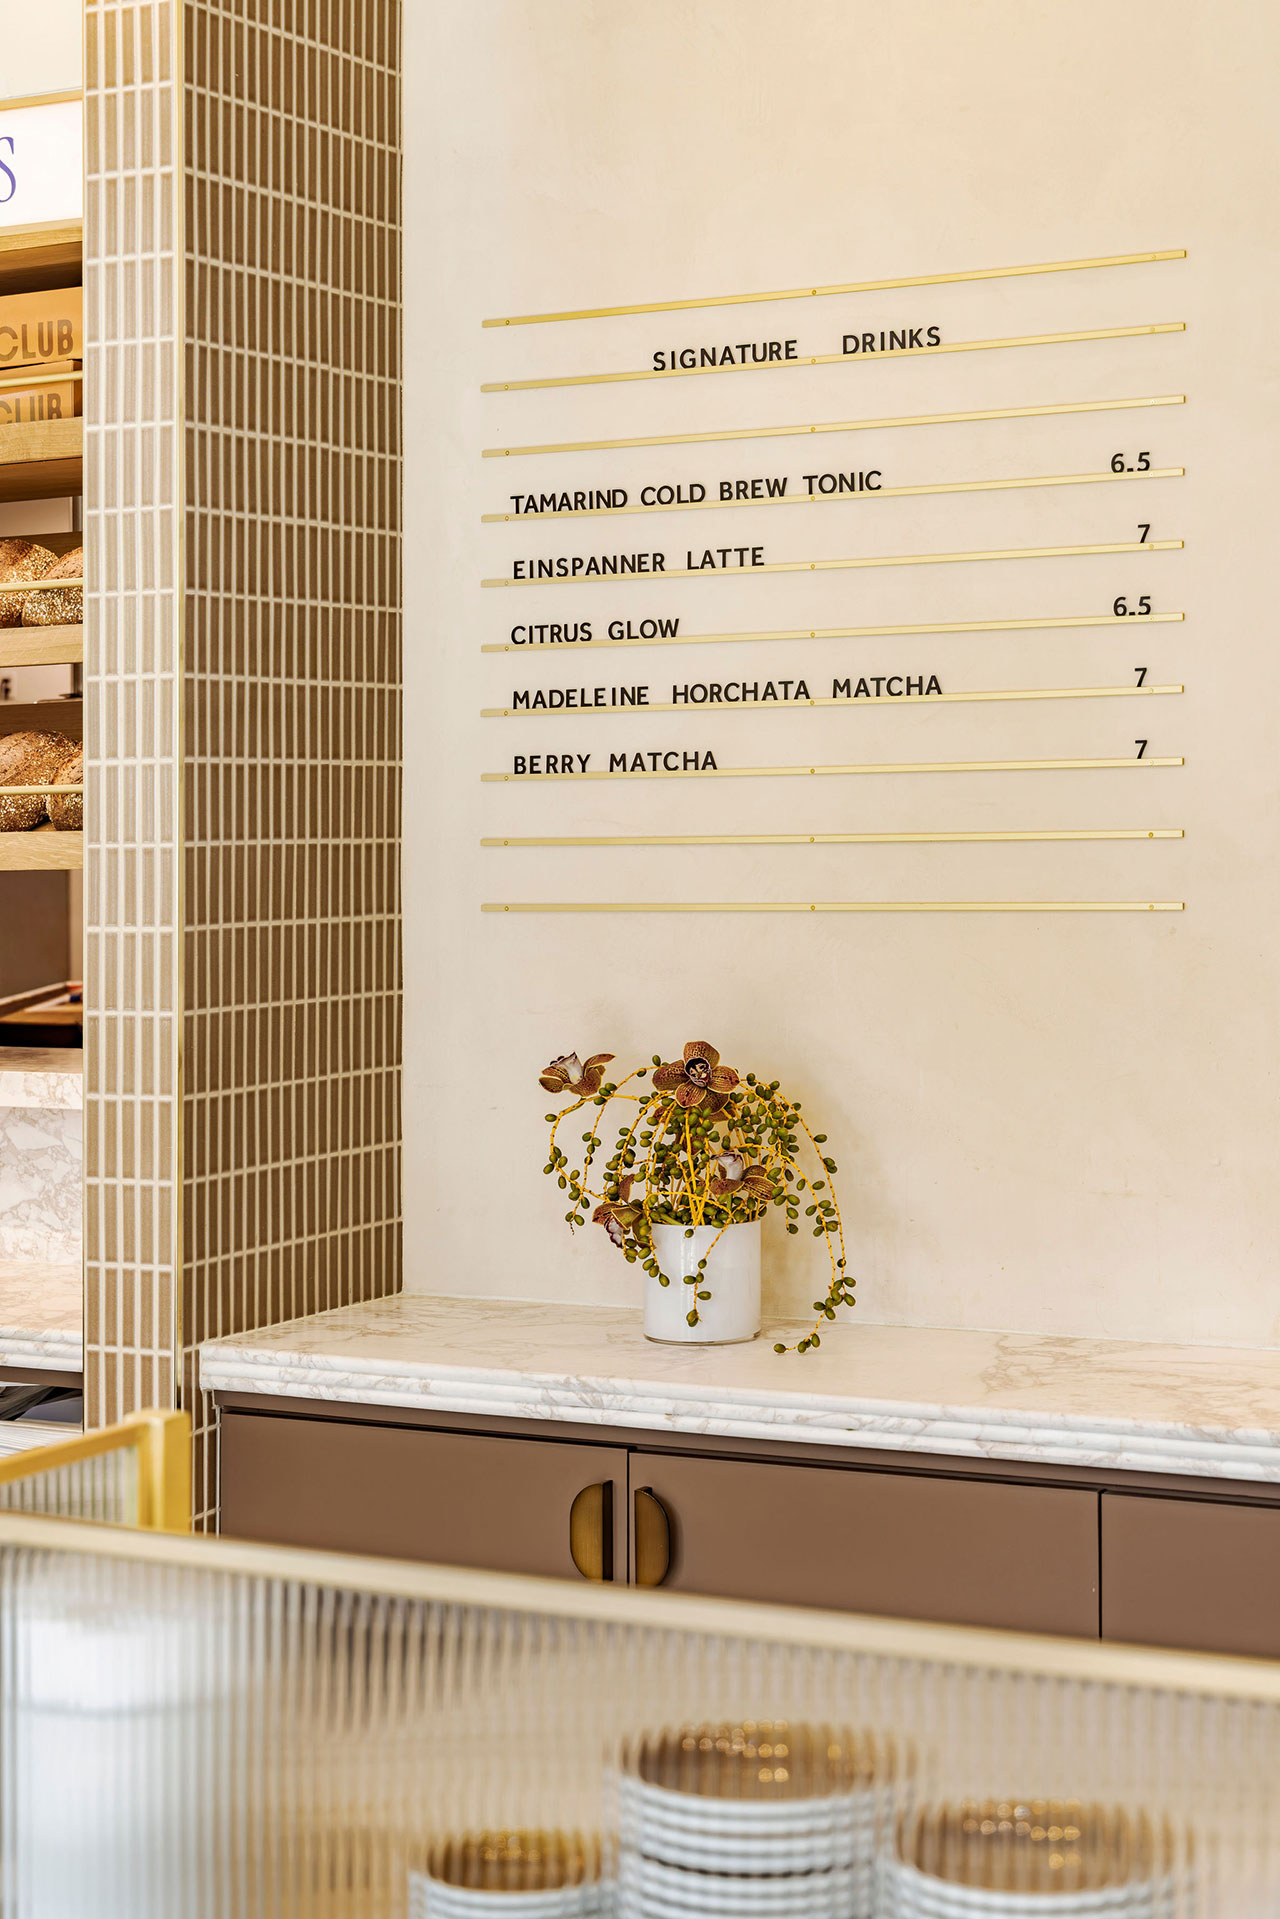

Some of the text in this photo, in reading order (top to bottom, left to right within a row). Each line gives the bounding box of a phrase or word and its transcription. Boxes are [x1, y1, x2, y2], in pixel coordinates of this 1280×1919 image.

[0, 319, 74, 362] CLUB
[653, 326, 941, 372] SIGNATURE DRINKS
[510, 451, 1151, 515] TAMARIND COLD BREW TONIC 6.5
[513, 523, 1151, 580] EINSPANNER LATTE 7
[511, 595, 1151, 645] CITRUS GLOW 6.5
[512, 667, 1148, 710] MADELEINE HORCHATA MATCHA 7
[514, 739, 1148, 775] BERRY MATCHA 7
